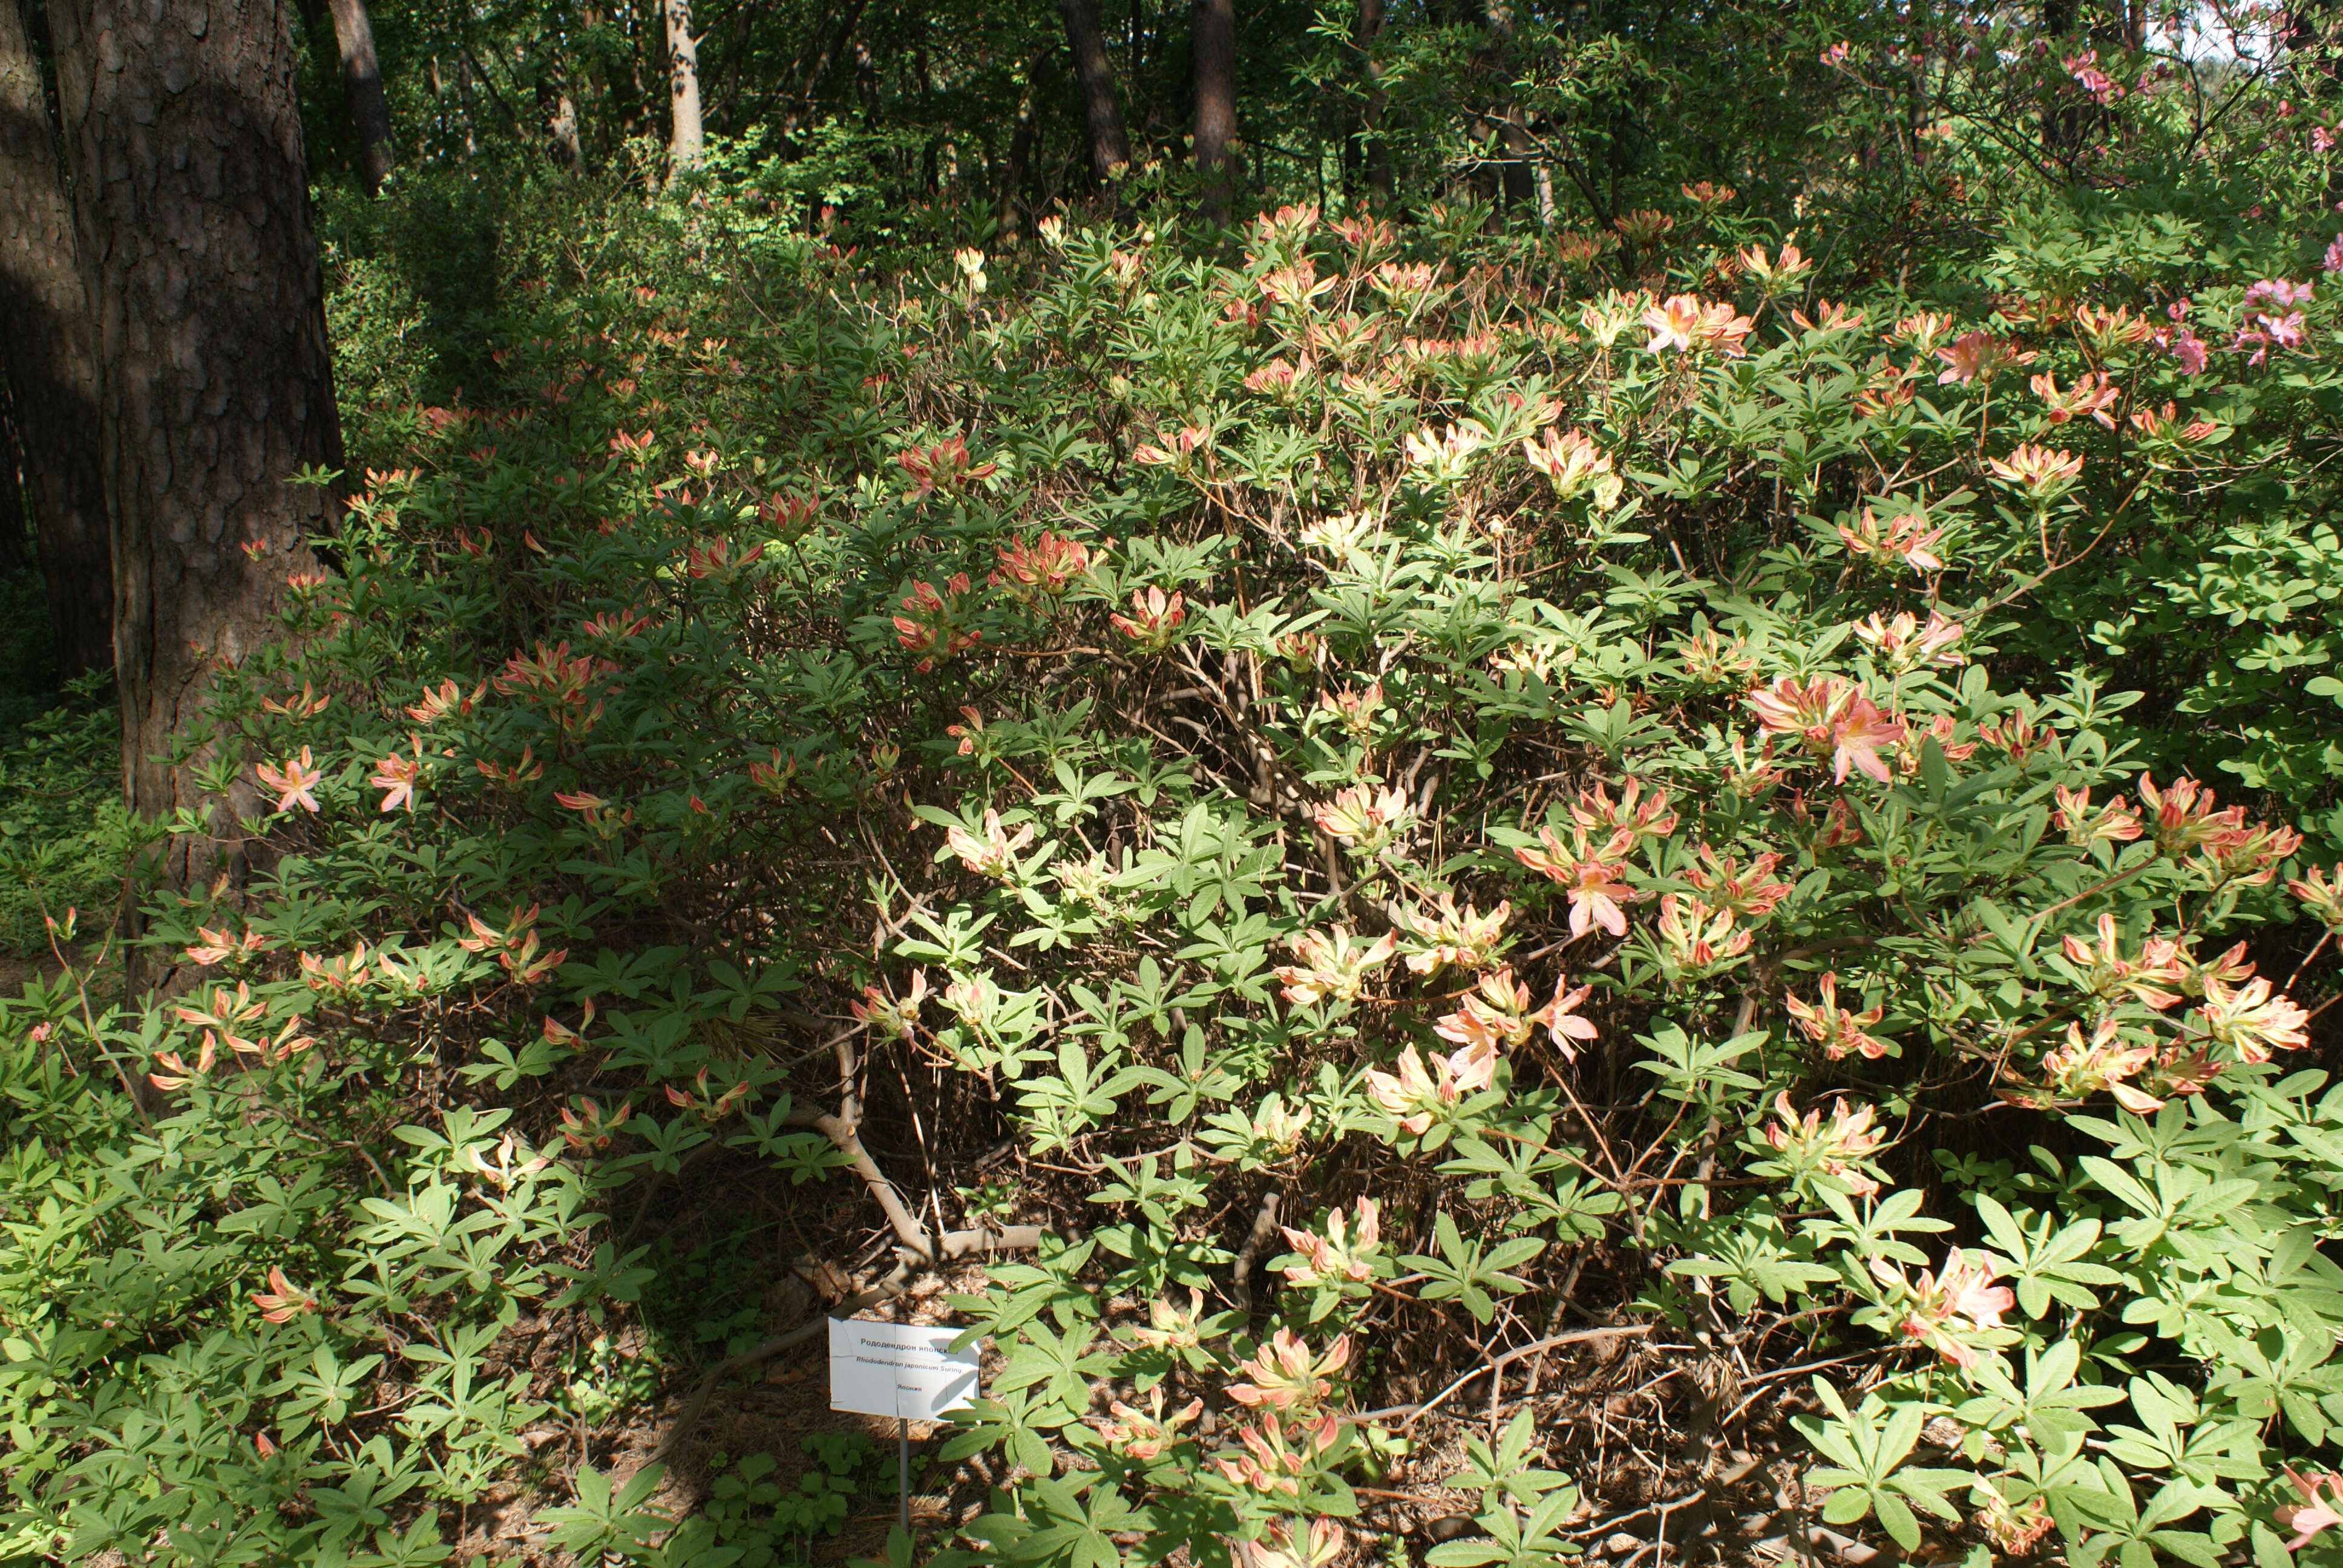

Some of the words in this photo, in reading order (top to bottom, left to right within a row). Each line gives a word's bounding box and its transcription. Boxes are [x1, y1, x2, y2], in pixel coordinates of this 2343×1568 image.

[860, 1338, 916, 1351] Рододендрон
[919, 1345, 958, 1355] японск
[856, 1356, 903, 1368] Rhododendron
[904, 1361, 939, 1371] japonicum
[897, 1383, 922, 1392] Япония
